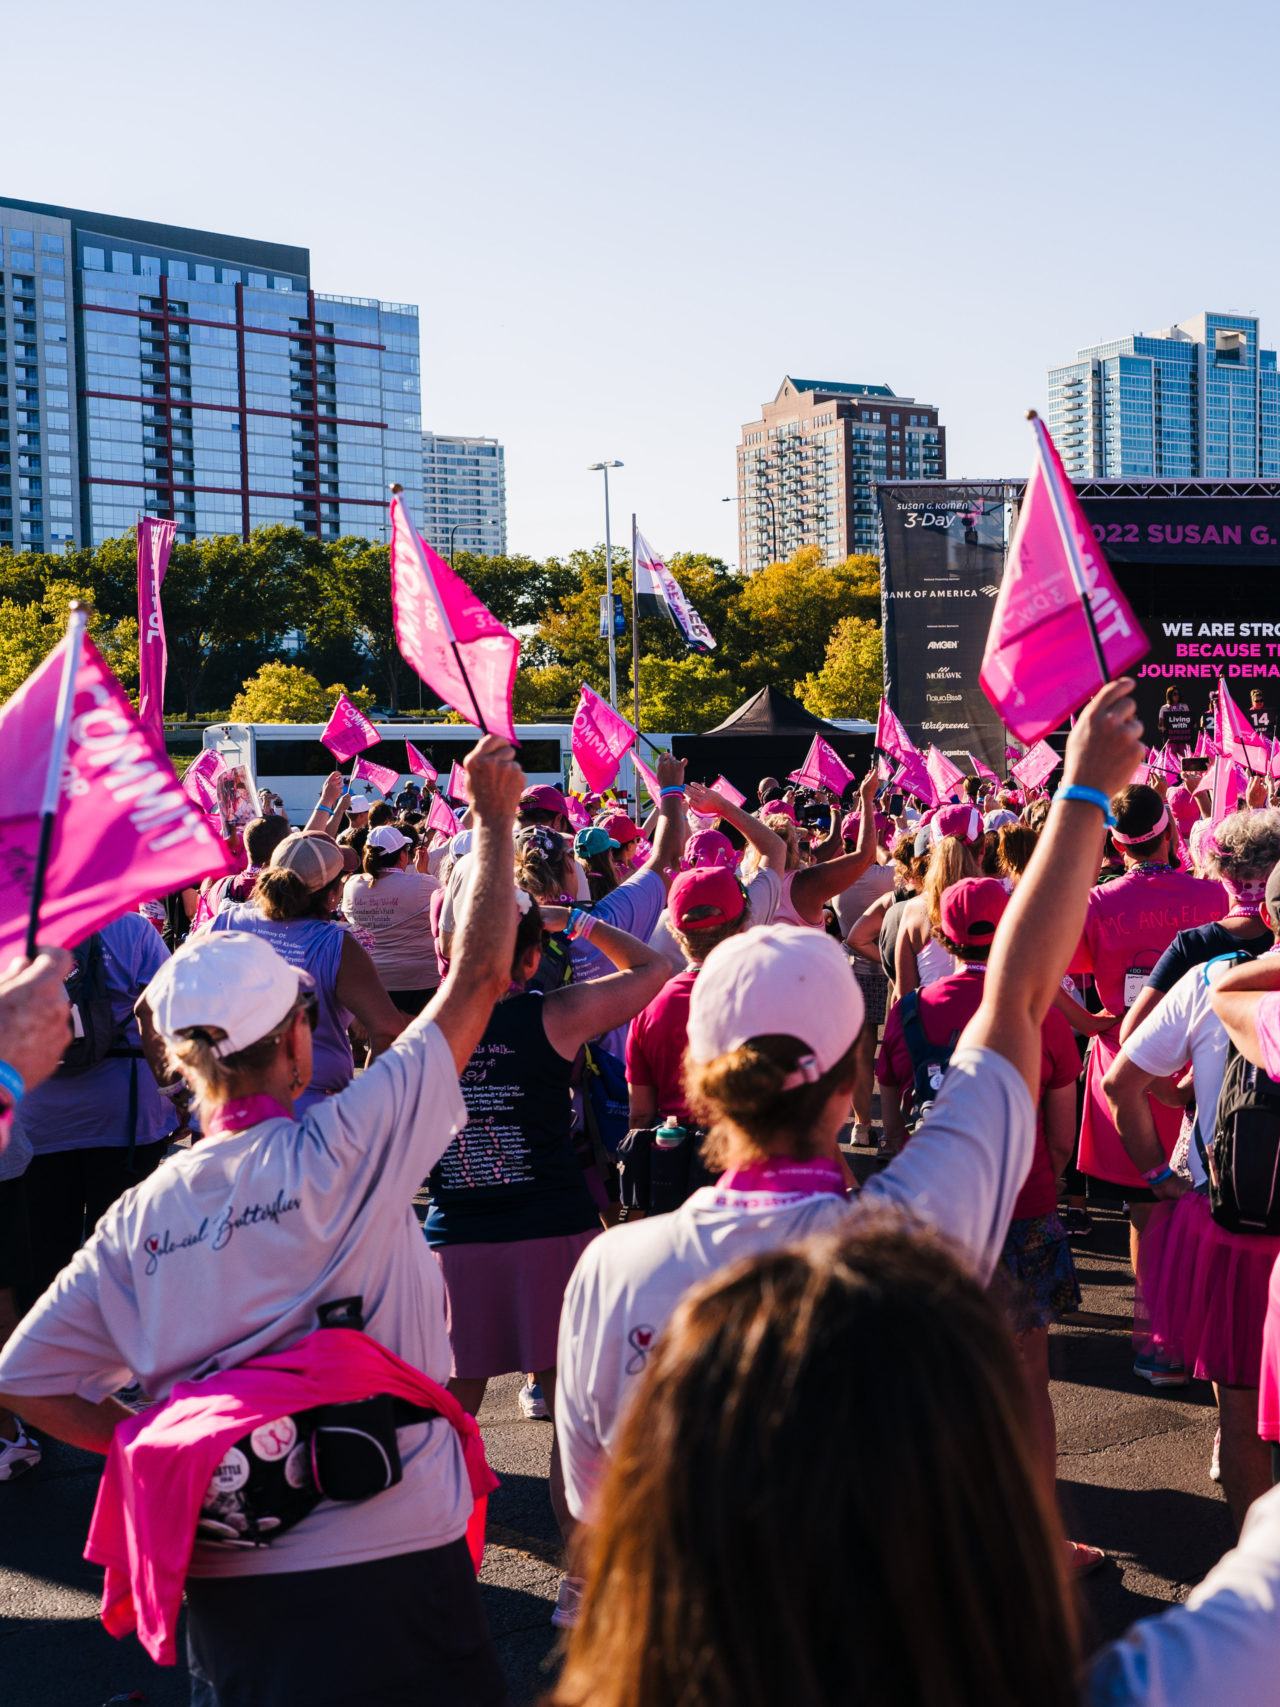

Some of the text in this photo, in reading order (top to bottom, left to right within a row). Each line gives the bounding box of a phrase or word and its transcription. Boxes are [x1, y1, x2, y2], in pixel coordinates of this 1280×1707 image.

[896, 502, 925, 510] susan
[935, 502, 968, 510] komen
[1091, 524, 1140, 543] 022
[1147, 524, 1242, 545] SUSAN
[1250, 525, 1277, 545] G.
[914, 590, 928, 598] OF
[929, 589, 978, 598] AMERICA
[1161, 622, 1194, 637] WE
[1197, 622, 1235, 637] ARE
[927, 640, 959, 650] AMGEN
[1176, 643, 1261, 658] BECAUSE
[926, 672, 962, 680] MOHAWK
[1137, 664, 1225, 678] JOURNEY
[340, 702, 377, 740] COMMIT
[1168, 716, 1191, 726] Living
[1250, 712, 1270, 727] 14
[921, 721, 970, 732] Walgreens
[1171, 722, 1188, 730] with
[572, 736, 583, 748] OR
[1139, 904, 1204, 929] ANGEL
